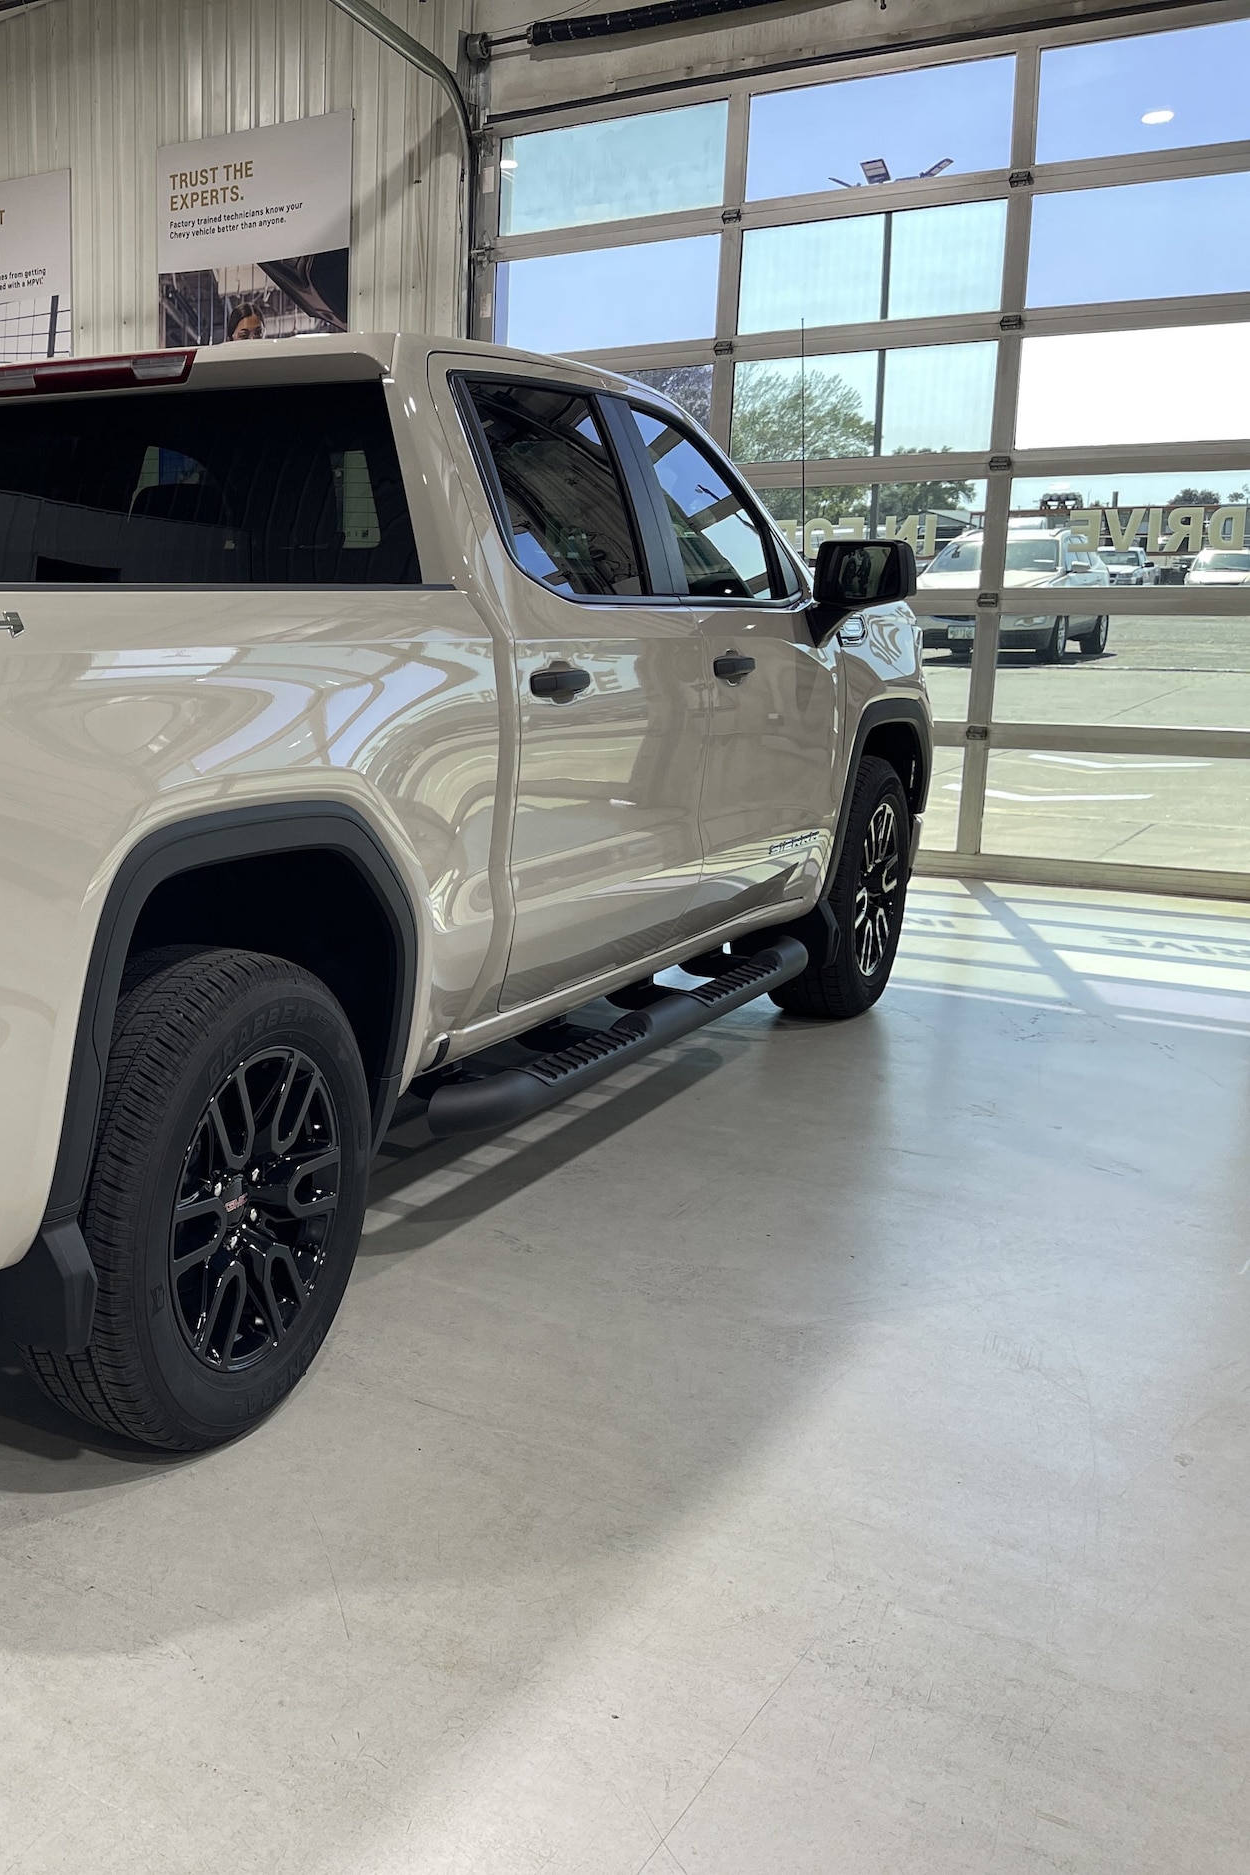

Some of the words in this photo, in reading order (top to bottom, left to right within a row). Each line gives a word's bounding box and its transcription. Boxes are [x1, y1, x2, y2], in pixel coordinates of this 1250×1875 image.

[170, 166, 219, 190] TRUST
[223, 160, 254, 182] THE
[170, 185, 245, 212] EXPERTS.
[169, 217, 196, 229] Factory
[197, 213, 222, 224] trained
[223, 207, 264, 222] technicians
[265, 204, 285, 215] know
[286, 200, 303, 214] your
[169, 230, 191, 239] Chevy
[192, 225, 216, 237] vehicle
[217, 222, 239, 233] better
[241, 219, 257, 229] than
[258, 216, 287, 228] anyone.
[7, 280, 21, 289] with
[9, 270, 24, 280] from
[24, 267, 47, 278] getting
